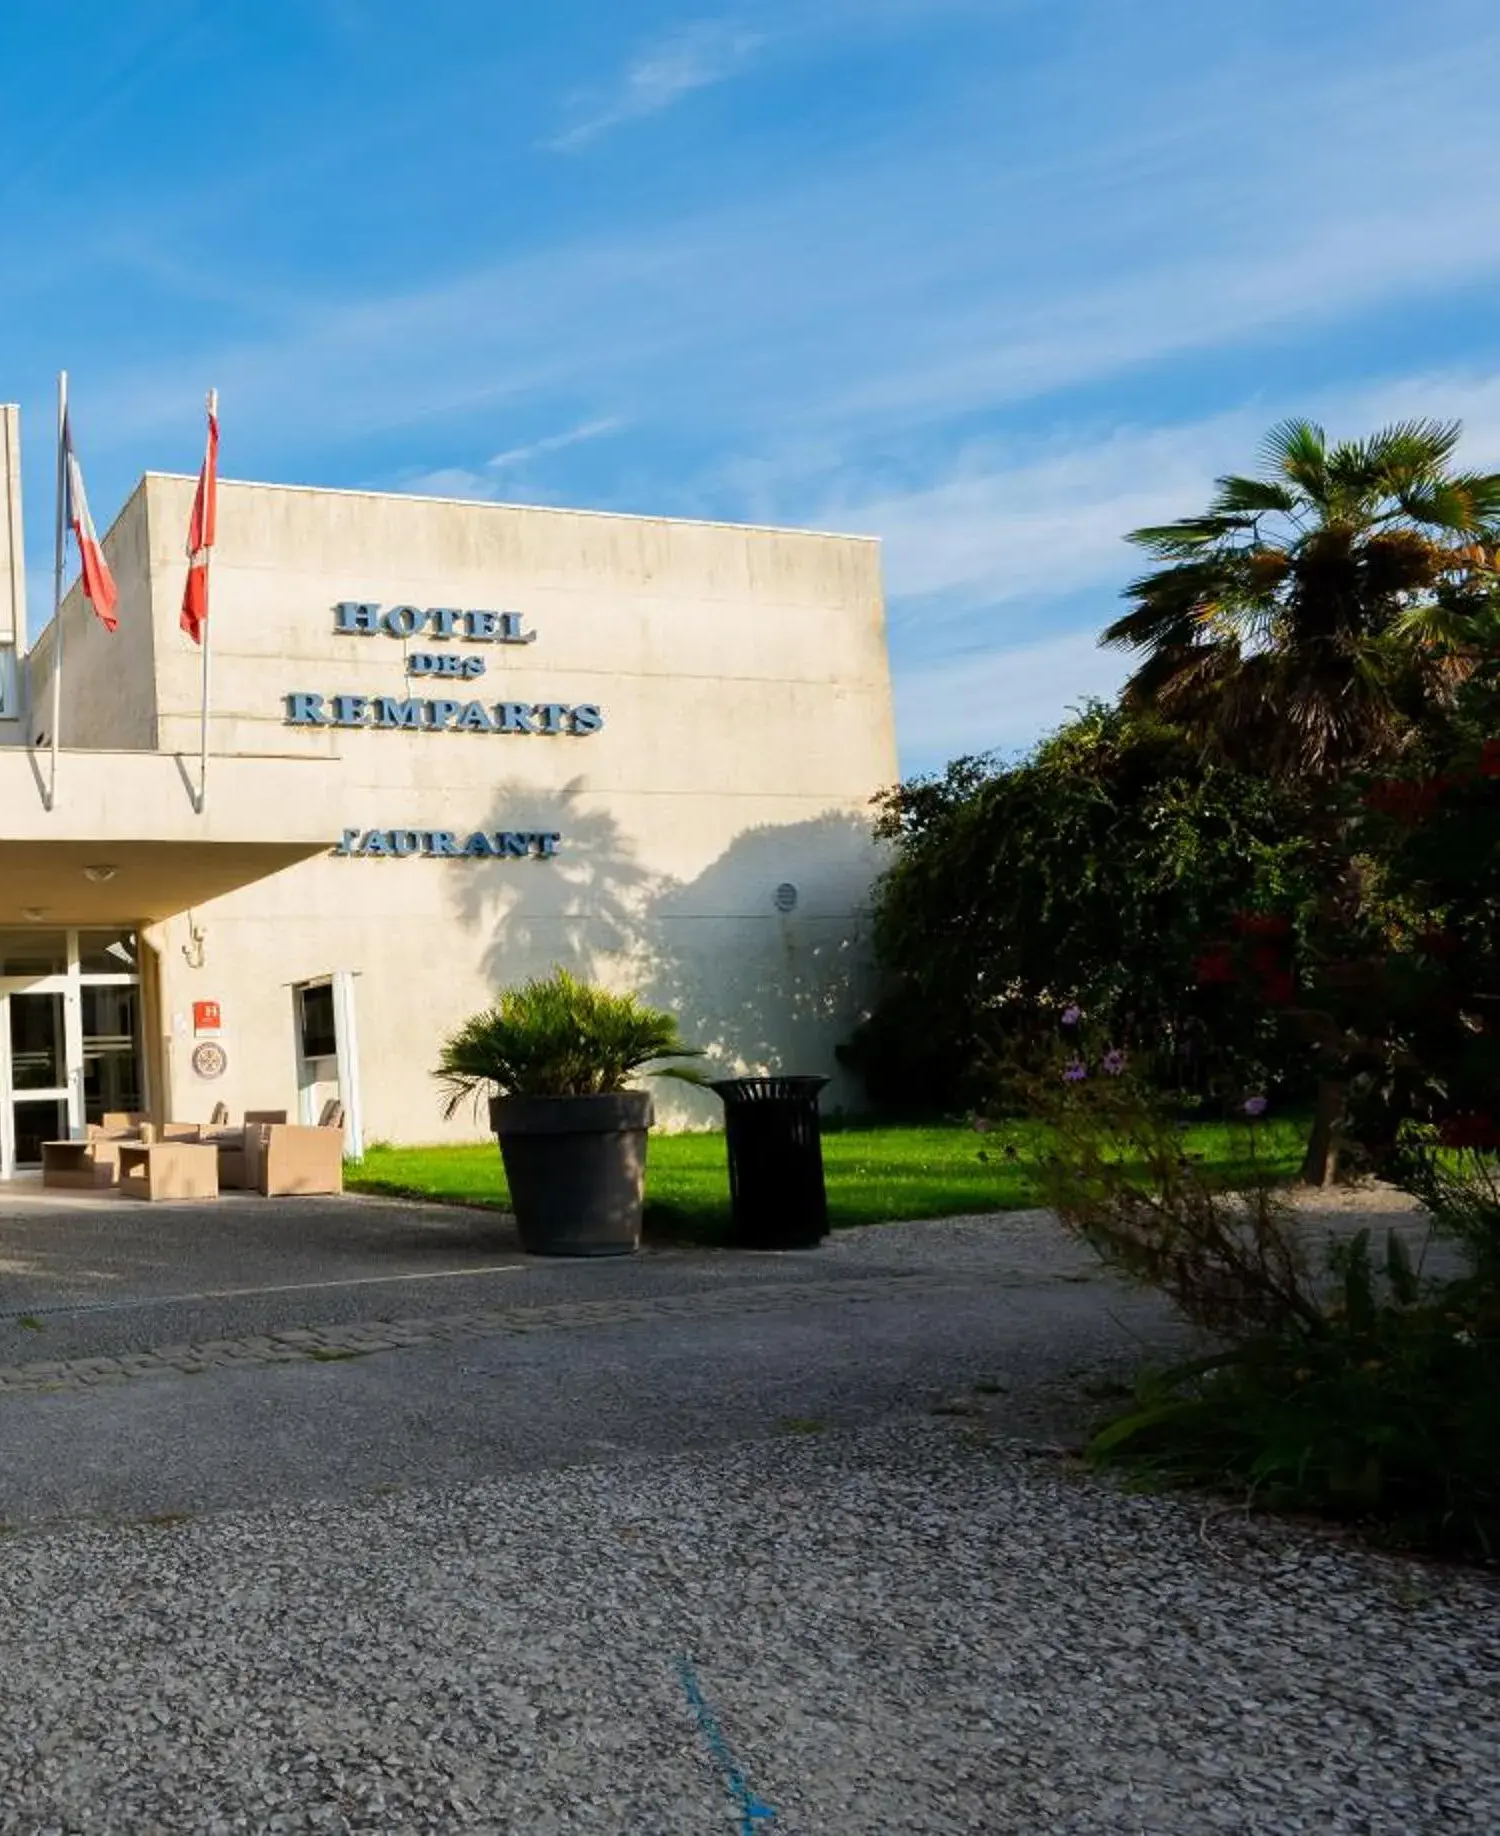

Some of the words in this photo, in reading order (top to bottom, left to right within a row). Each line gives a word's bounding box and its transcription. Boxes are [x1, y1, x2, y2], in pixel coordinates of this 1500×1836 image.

[332, 602, 537, 643] HOTEL
[407, 653, 486, 679] DES
[283, 692, 603, 735] REMPARTS
